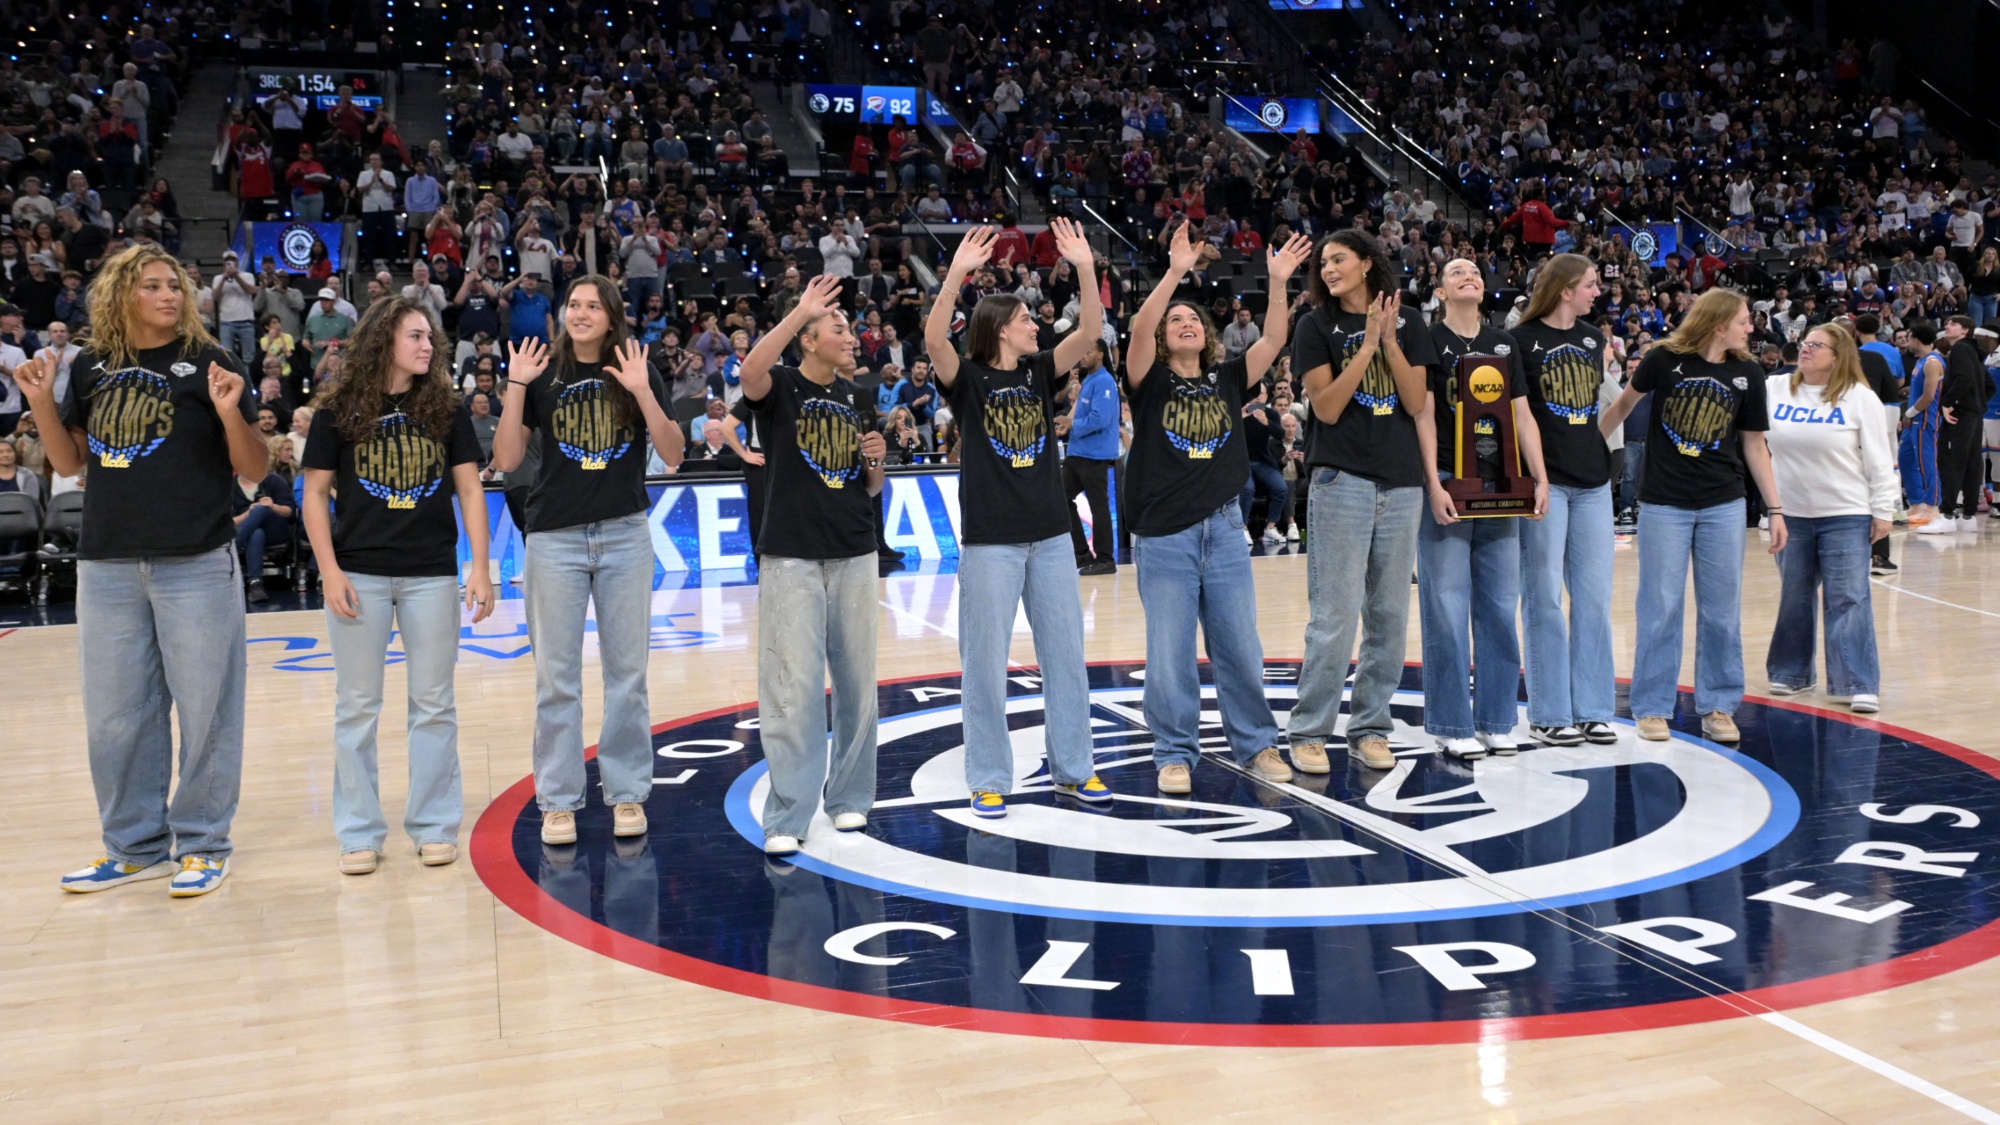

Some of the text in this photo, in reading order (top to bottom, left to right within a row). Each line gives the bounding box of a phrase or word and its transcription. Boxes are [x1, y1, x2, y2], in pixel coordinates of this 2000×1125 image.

[298, 74, 336, 92] 1:54
[352, 78, 366, 90] 24
[833, 97, 855, 113] 75
[890, 99, 912, 115] 92
[527, 242, 547, 254] LA
[1473, 382, 1504, 395] NCAA
[87, 386, 175, 449] HAMPS
[1162, 397, 1233, 443] CHAMPS
[1567, 412, 1589, 425] Ucla
[1661, 395, 1734, 444] CHAMPS
[1773, 402, 1846, 426] UCLA
[795, 415, 862, 471] CHAMP
[1677, 442, 1701, 458] Ucla
[101, 451, 132, 469] Ucla
[1011, 453, 1035, 468] Ucla
[1188, 446, 1213, 460] Ucla
[353, 434, 446, 491] CHAMPS
[581, 456, 608, 471] Ucla
[387, 494, 417, 510] Ucla
[1471, 500, 1497, 509] NATIONAL
[824, 802, 1981, 997] CLIPPERS
